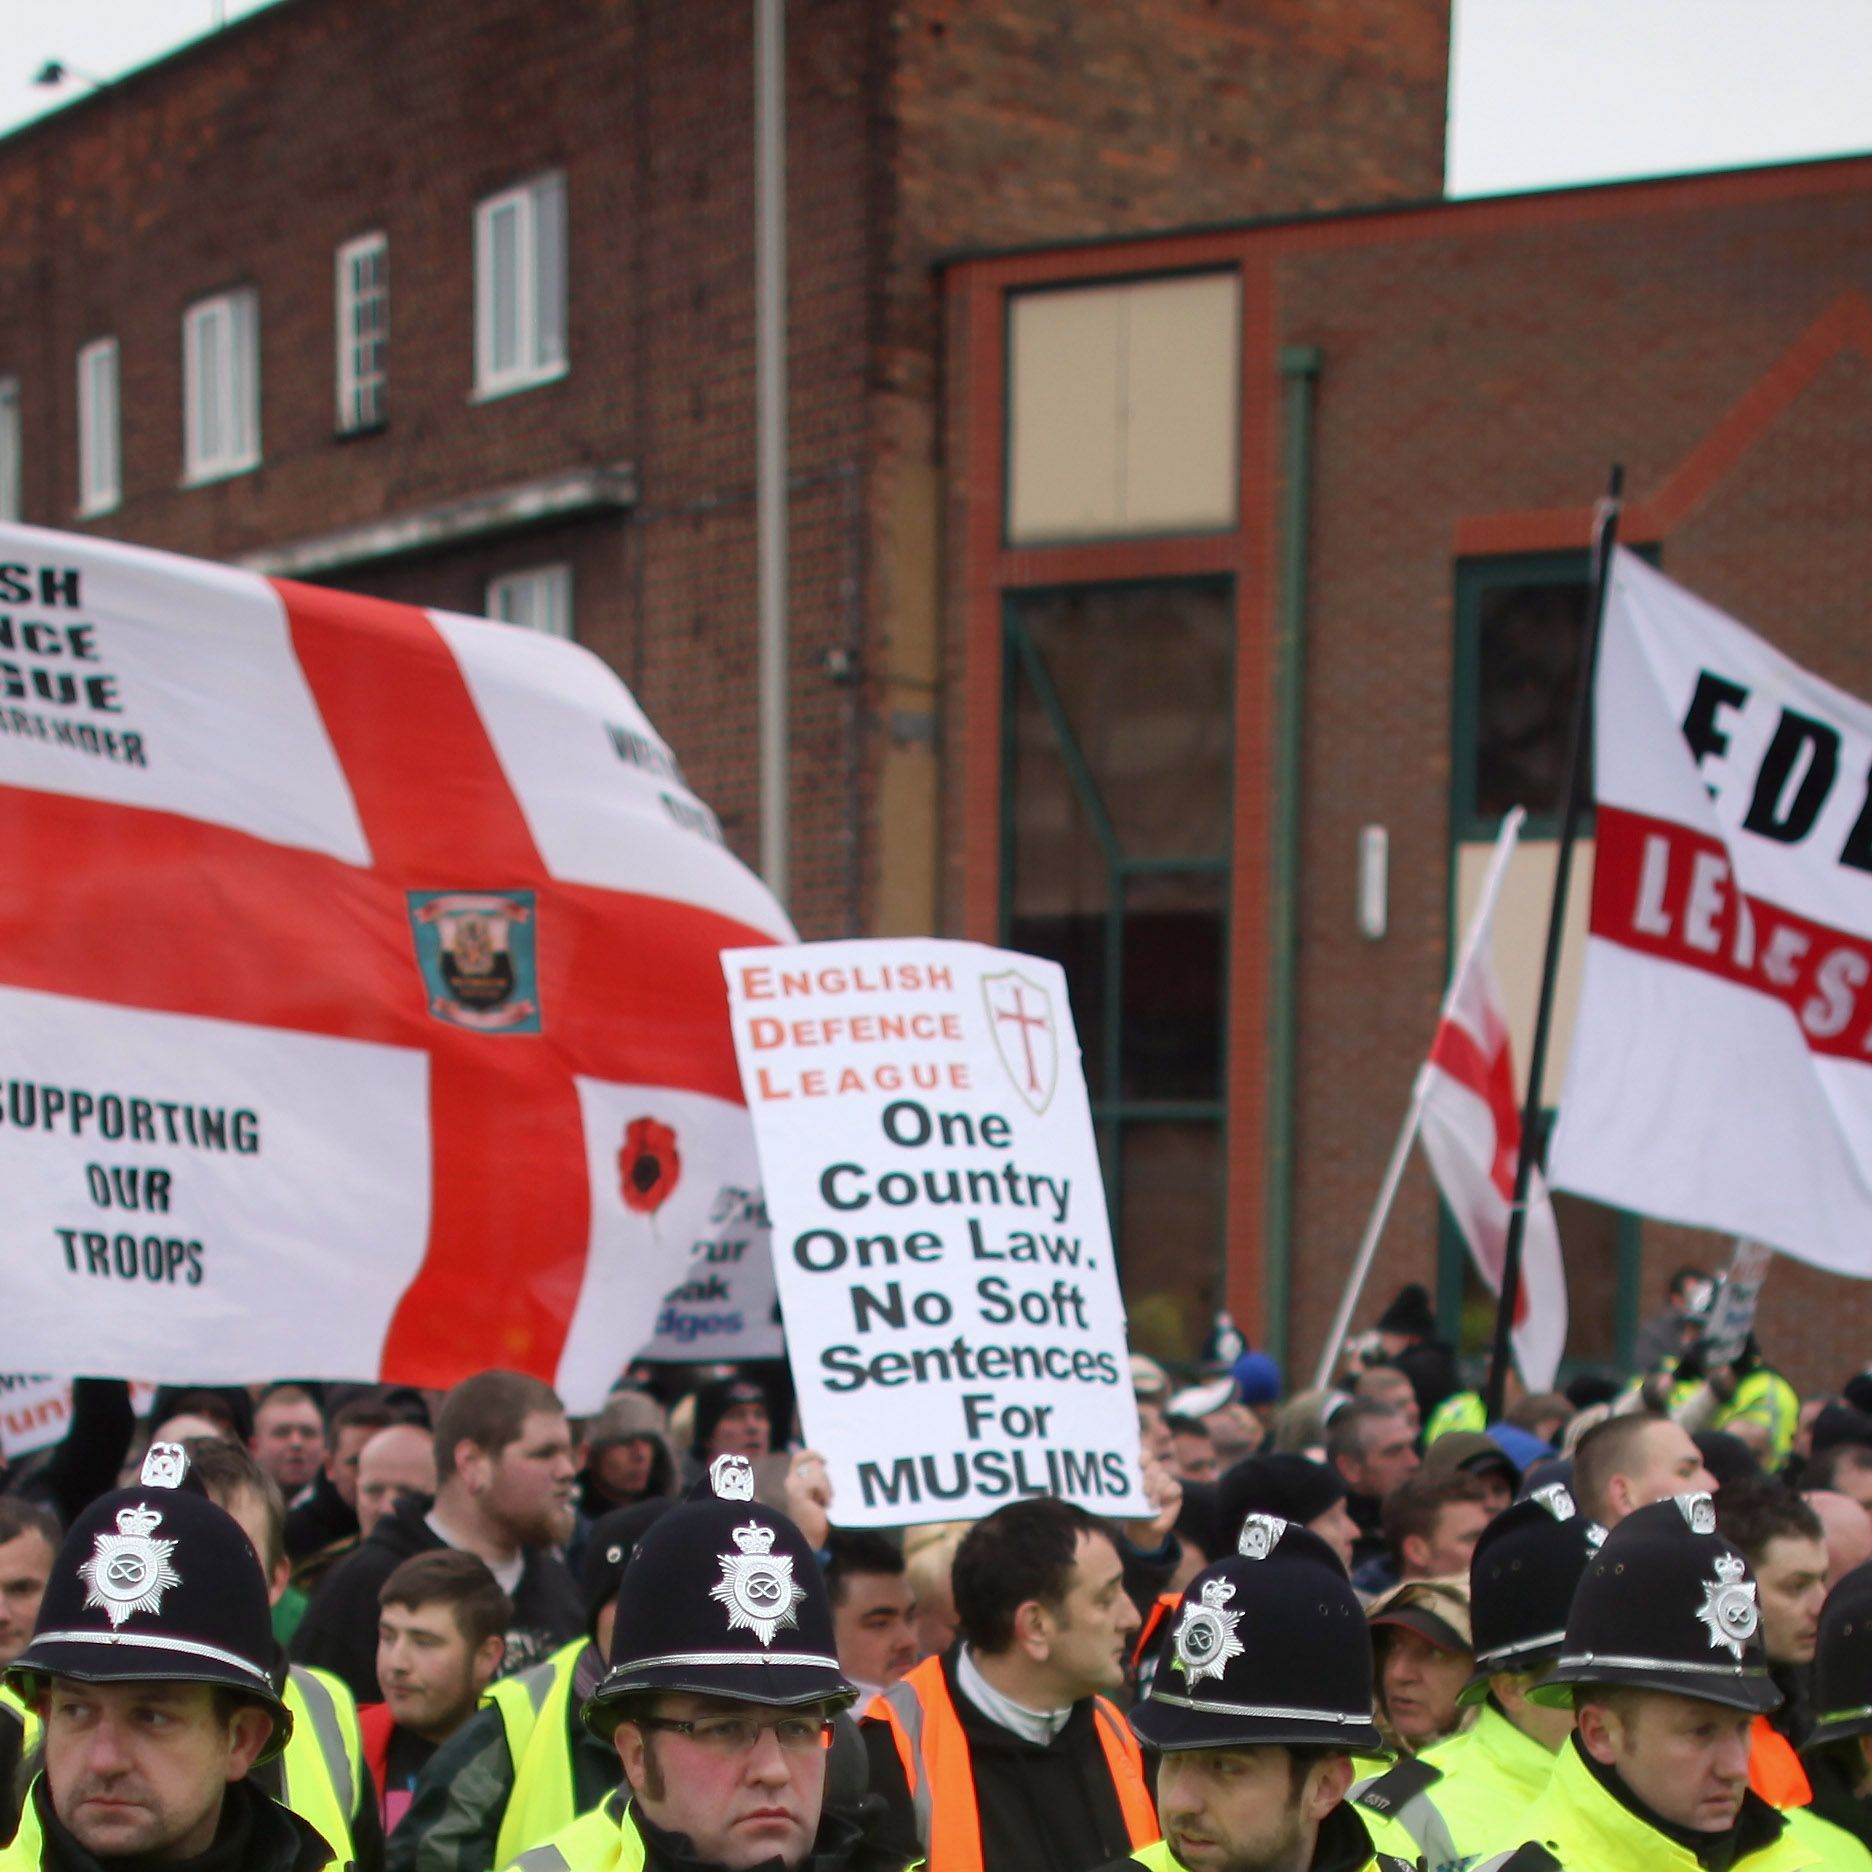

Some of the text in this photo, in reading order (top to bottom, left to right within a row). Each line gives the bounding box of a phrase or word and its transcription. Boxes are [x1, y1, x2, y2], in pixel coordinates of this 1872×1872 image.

[740, 964, 953, 1001] ENGLISH
[748, 1012, 964, 1051] DEFENCE
[757, 1062, 973, 1102] LEAGUE
[881, 1100, 1014, 1149] One
[85, 1162, 172, 1214] OUR
[819, 1161, 1071, 1223] Country
[54, 1226, 203, 1287] TROOPS
[793, 1218, 1097, 1271] One Law.
[849, 1276, 1090, 1333] No Soft
[820, 1336, 1120, 1393] Sentences
[961, 1393, 1052, 1440] For
[856, 1449, 1130, 1508] MUSLIMS
